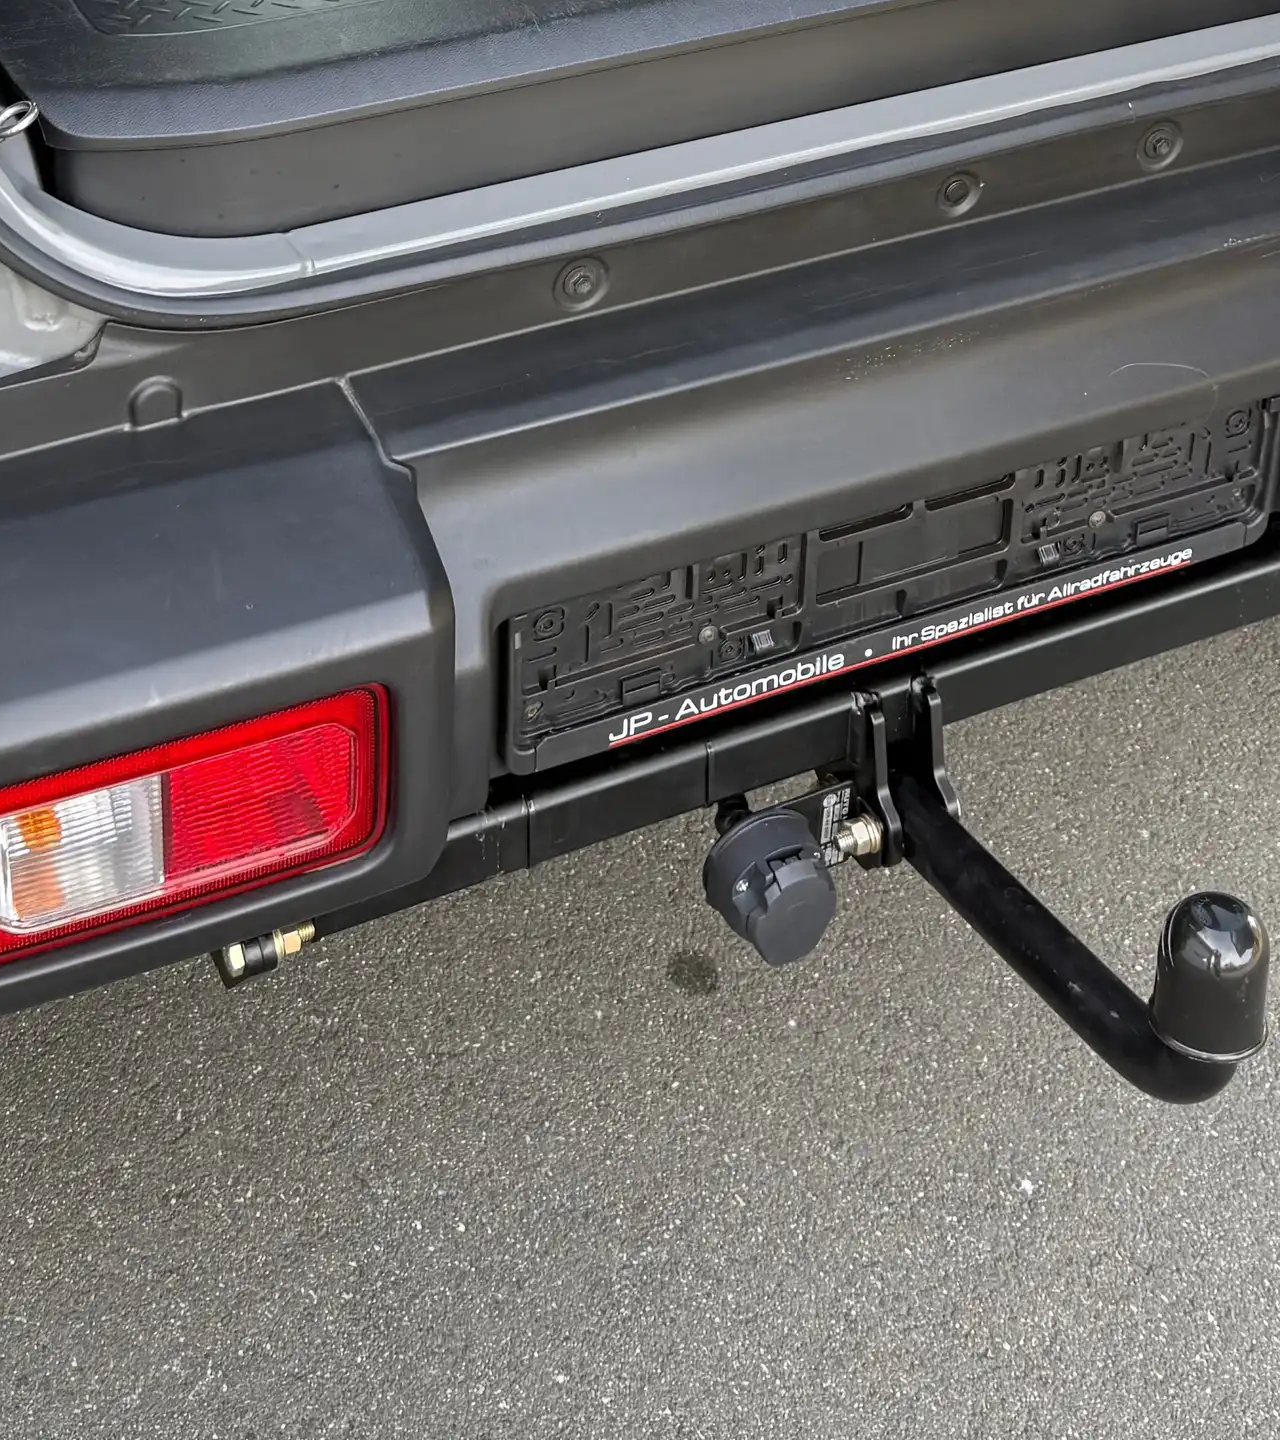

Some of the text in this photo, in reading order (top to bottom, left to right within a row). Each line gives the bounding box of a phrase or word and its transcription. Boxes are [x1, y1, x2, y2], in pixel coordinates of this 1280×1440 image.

[609, 712, 652, 741] JP
[675, 651, 844, 720] Automobile
[892, 632, 919, 651] Ihr
[921, 601, 1014, 642] Spezialist
[1017, 593, 1046, 611] für
[1048, 547, 1193, 601] Allradfahrzeuge
